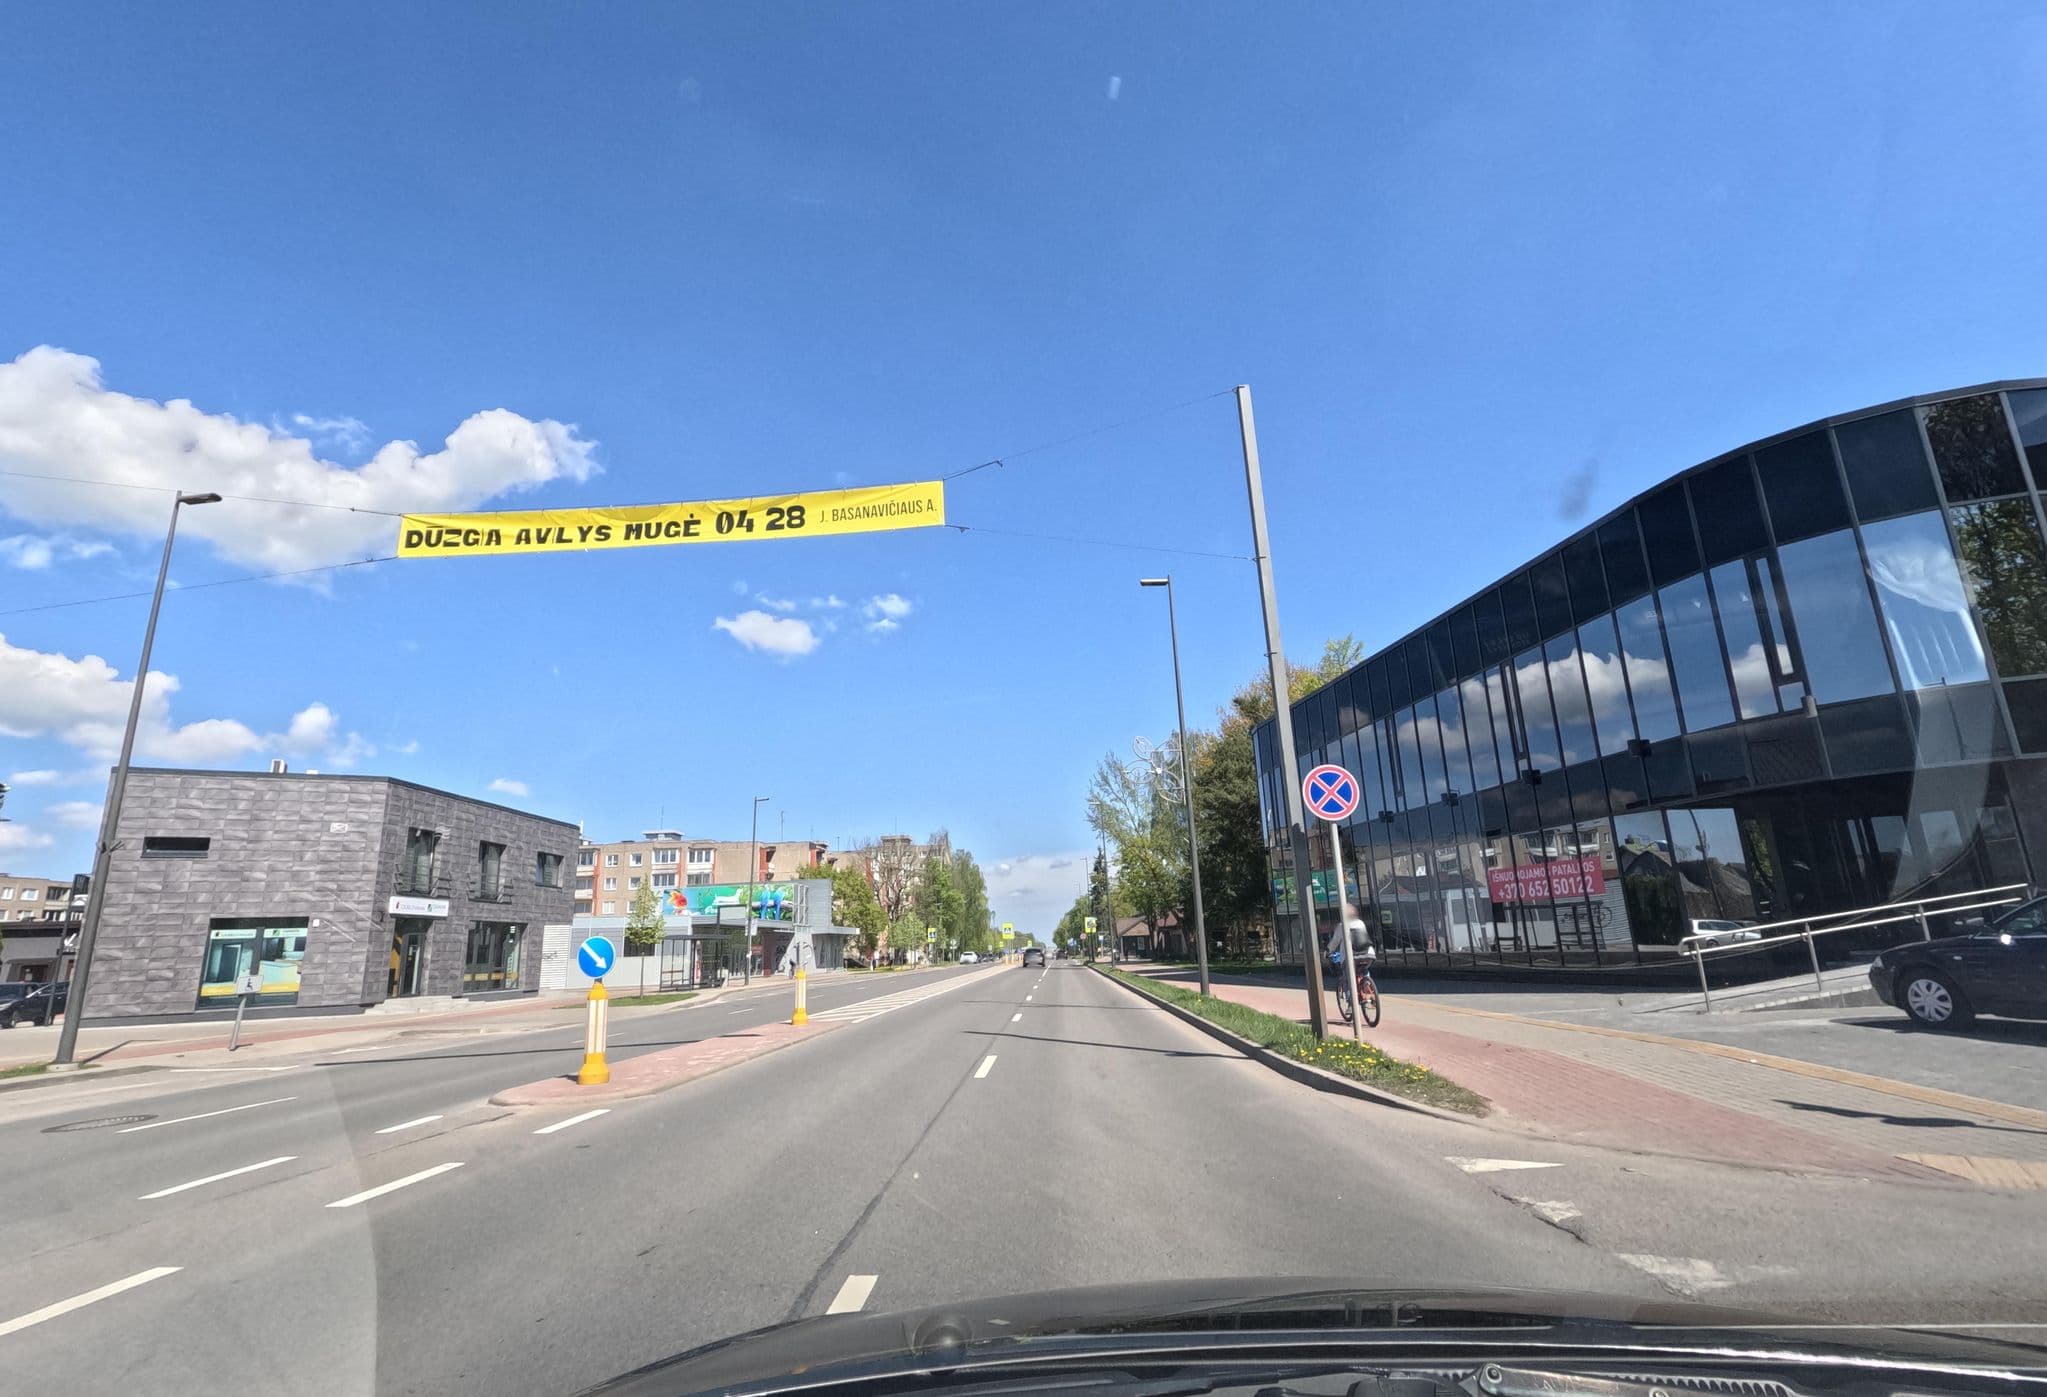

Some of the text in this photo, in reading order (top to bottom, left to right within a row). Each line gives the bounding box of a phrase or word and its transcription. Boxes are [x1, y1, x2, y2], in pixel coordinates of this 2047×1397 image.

[623, 513, 701, 541] MUGĖ
[715, 510, 754, 535] 04
[765, 505, 806, 531] 28
[819, 512, 829, 523] J.
[832, 501, 923, 522] BASANAVIČIAUS
[926, 499, 938, 512] A.
[1492, 867, 1551, 882] IŠNUOOJAMO
[1498, 875, 1595, 899] +370 652 50122
